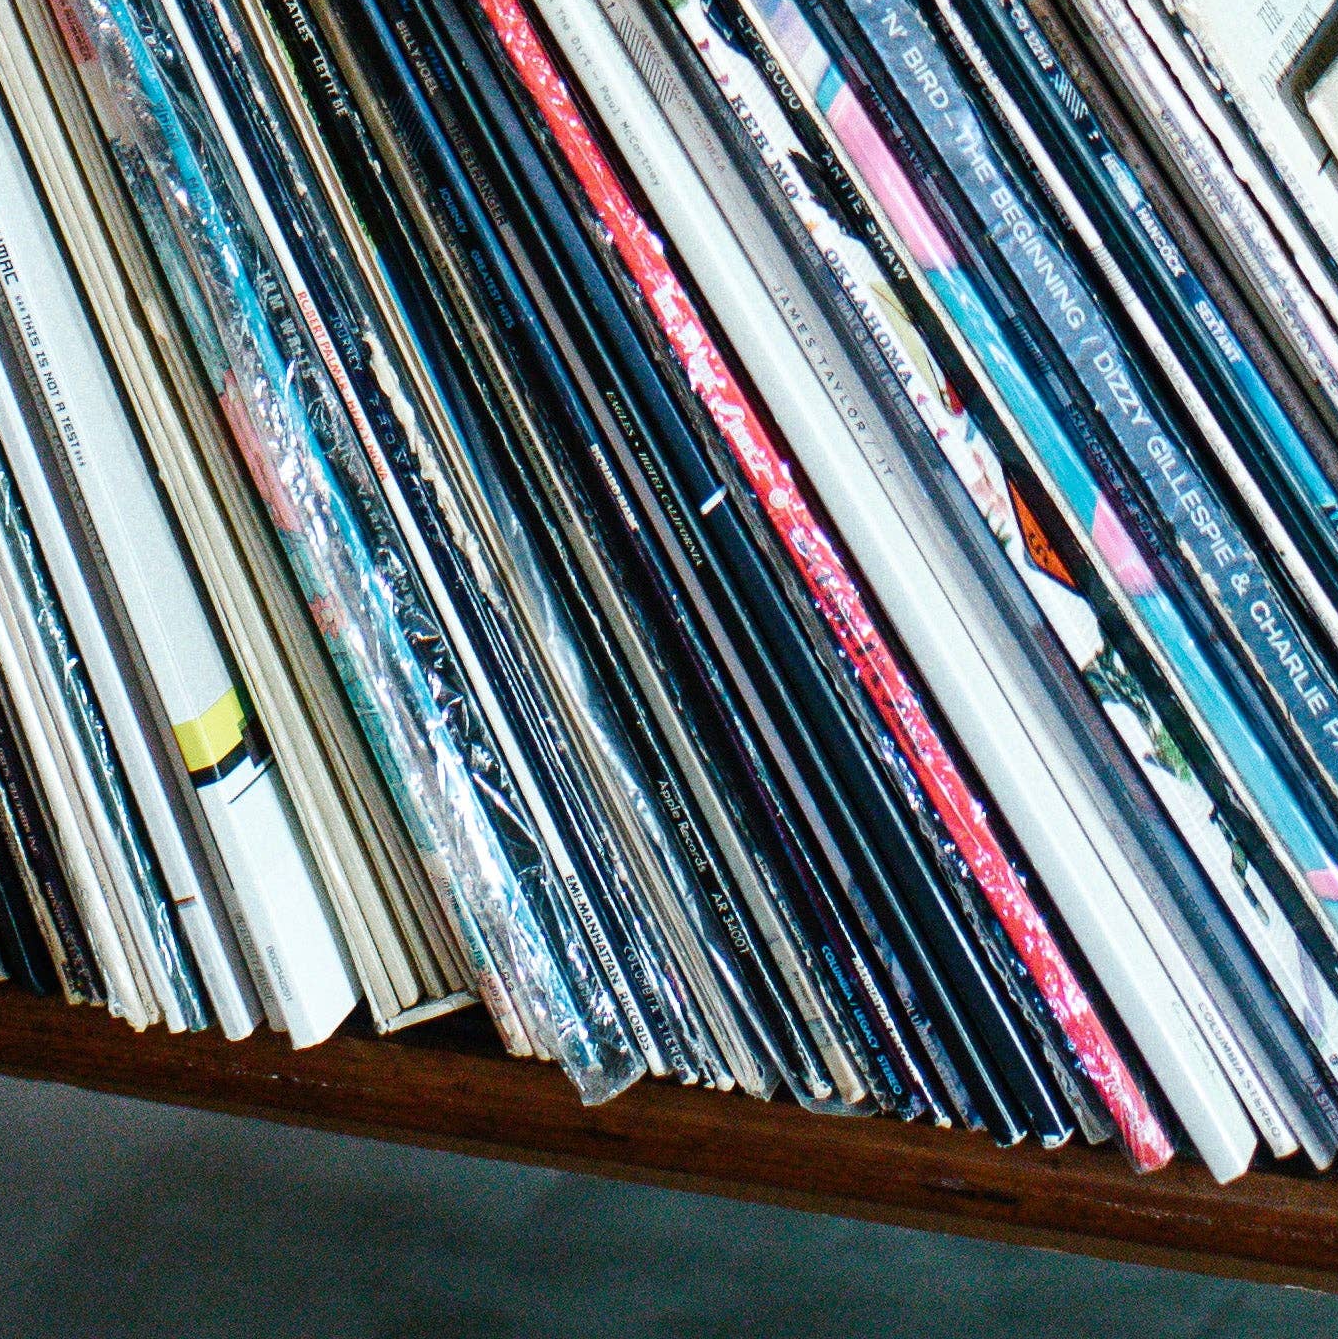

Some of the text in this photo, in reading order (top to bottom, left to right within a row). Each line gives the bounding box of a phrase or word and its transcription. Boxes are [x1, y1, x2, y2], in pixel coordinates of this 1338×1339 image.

[309, 54, 331, 81] LET
[321, 78, 338, 95] IT
[330, 96, 350, 118] BE
[393, 18, 508, 227] BILLY JOEL THE STRANGER
[554, 7, 575, 34] The
[569, 34, 594, 67] Dirt
[598, 84, 623, 117] Paul
[617, 119, 664, 188] McCartney
[947, 33, 972, 66] BEST
[967, 66, 984, 86] OF
[979, 85, 1036, 170] CANNONBALL
[1190, 133, 1218, 170] THE
[1214, 58, 1267, 136] BRUBECK
[1264, 139, 1316, 214] QUARTET
[436, 184, 517, 330] JOURNEY GREATEST HITS
[864, 218, 909, 282] SHAW
[899, 44, 953, 114] BIRD
[950, 125, 997, 184] THE
[987, 184, 1089, 332] BEGINNING
[1156, 108, 1315, 355] MILES DAVIS SEVEN
[256, 269, 317, 379] TOM WAITS
[328, 313, 364, 374] JOURNEY
[822, 244, 915, 388] OKLAHOMA
[1134, 205, 1186, 279] HANCOCK
[1192, 297, 1241, 366] SEXTANT
[42, 370, 60, 398] NOT
[296, 289, 389, 482] ROBERT PALMER NOVA
[432, 249, 459, 290] ELTON
[452, 289, 477, 327] JOHN
[475, 334, 511, 396] GOODBYE
[506, 397, 537, 450] YELLOW
[551, 488, 574, 525] ROAD
[772, 282, 894, 479] JAMES TAYLOR JT
[587, 442, 622, 495] RICHARD
[604, 388, 705, 567] EAGLES HOTEL CALIFORNIA
[1090, 348, 1151, 429] DIZZY
[1142, 431, 1238, 569] GILLESPIE
[1226, 568, 1255, 598] &
[1245, 597, 1330, 718] CHARLIE
[654, 776, 685, 822] Apple
[675, 818, 711, 874] Records
[710, 889, 730, 913] AR
[617, 989, 654, 1053] RECORDS
[621, 943, 661, 1014] COLUMBIA
[818, 943, 904, 1096] COLUMBIA LEGACY STEREO
[1196, 1000, 1283, 1140] COLUMBIA STEREO
